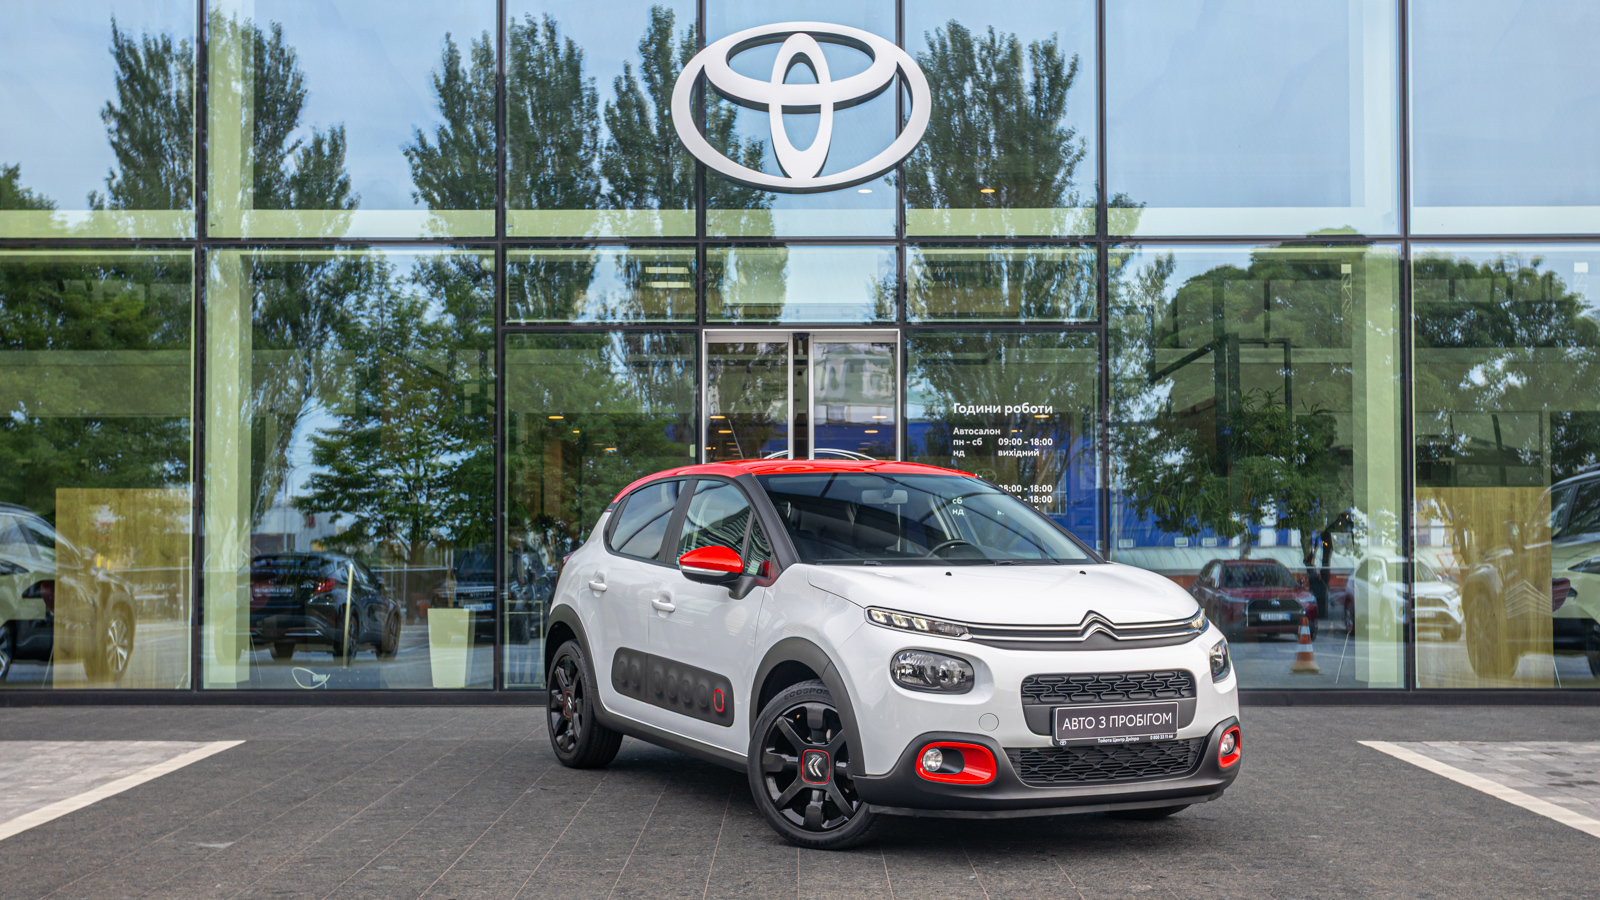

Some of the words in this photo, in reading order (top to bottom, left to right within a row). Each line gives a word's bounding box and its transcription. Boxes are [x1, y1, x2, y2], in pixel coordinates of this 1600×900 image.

[953, 403, 1001, 415] Години
[1004, 402, 1053, 416] роботи
[953, 427, 1001, 435] Автосалон
[972, 438, 983, 446] сб
[998, 438, 1022, 446] 09:00
[1030, 438, 1053, 446] 18:00
[953, 449, 965, 457] нд
[998, 448, 1039, 457] вихідний
[1030, 484, 1053, 493] 18:00
[952, 496, 963, 504] сб
[1030, 495, 1052, 503] 18:00
[784, 688, 832, 700] ECOSPOR
[1062, 717, 1095, 730] АВТО
[1109, 712, 1172, 728] ПРОБІГОМ
